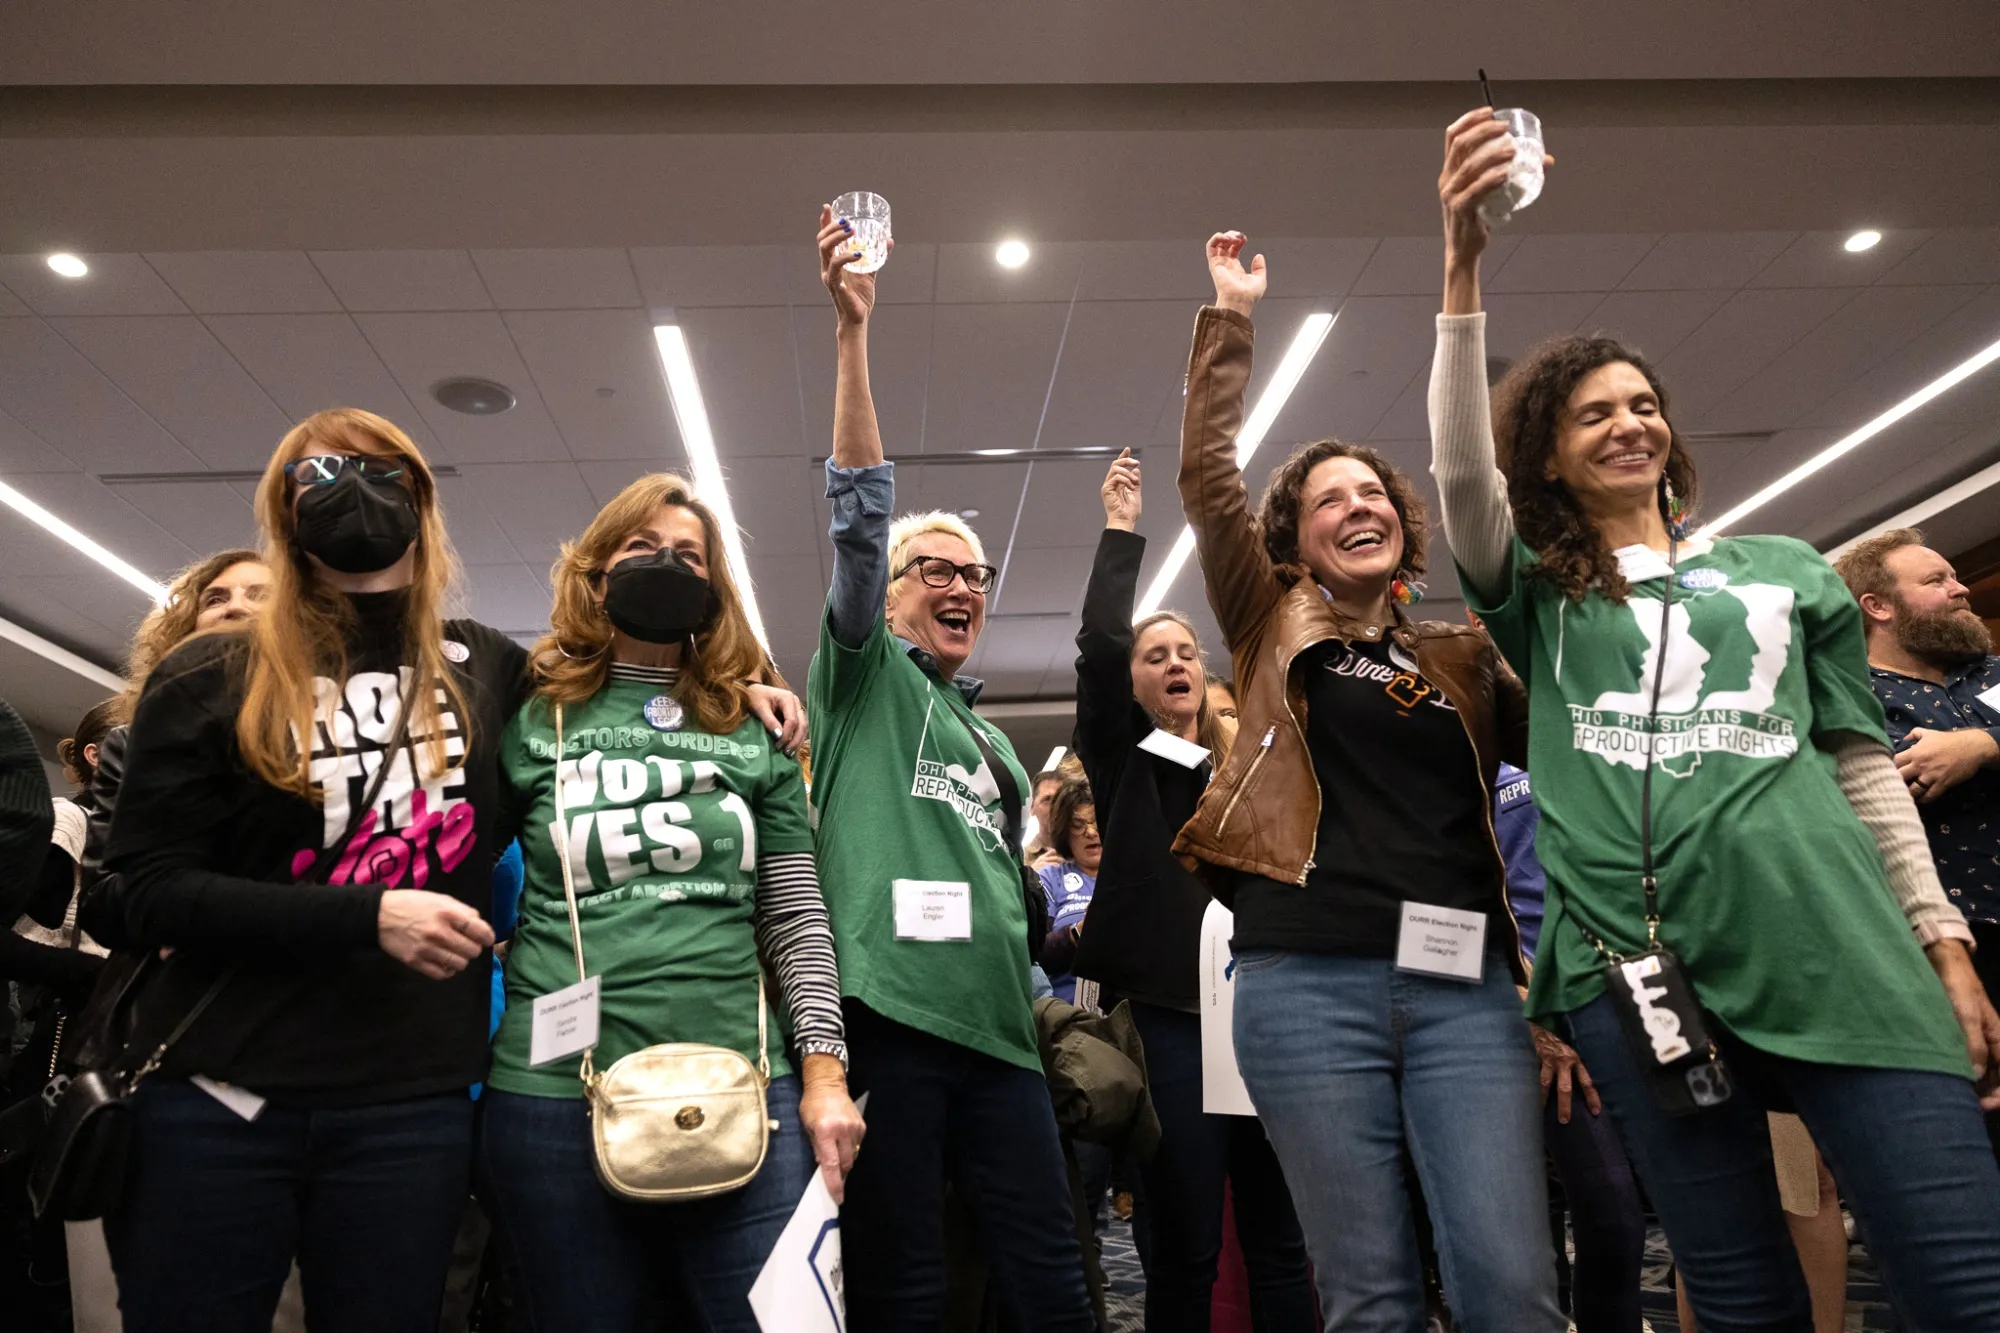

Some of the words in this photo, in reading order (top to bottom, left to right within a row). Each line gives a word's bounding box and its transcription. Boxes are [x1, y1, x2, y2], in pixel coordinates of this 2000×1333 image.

[290, 665, 460, 755] ROE
[1757, 715, 1793, 737] FOR
[662, 731, 761, 759] ORDERS
[1718, 727, 1796, 757] RIGHTS
[306, 736, 467, 849] THE
[1500, 779, 1531, 805] REPR
[713, 838, 734, 851] on
[719, 791, 755, 872] 1
[548, 801, 702, 894] YES
